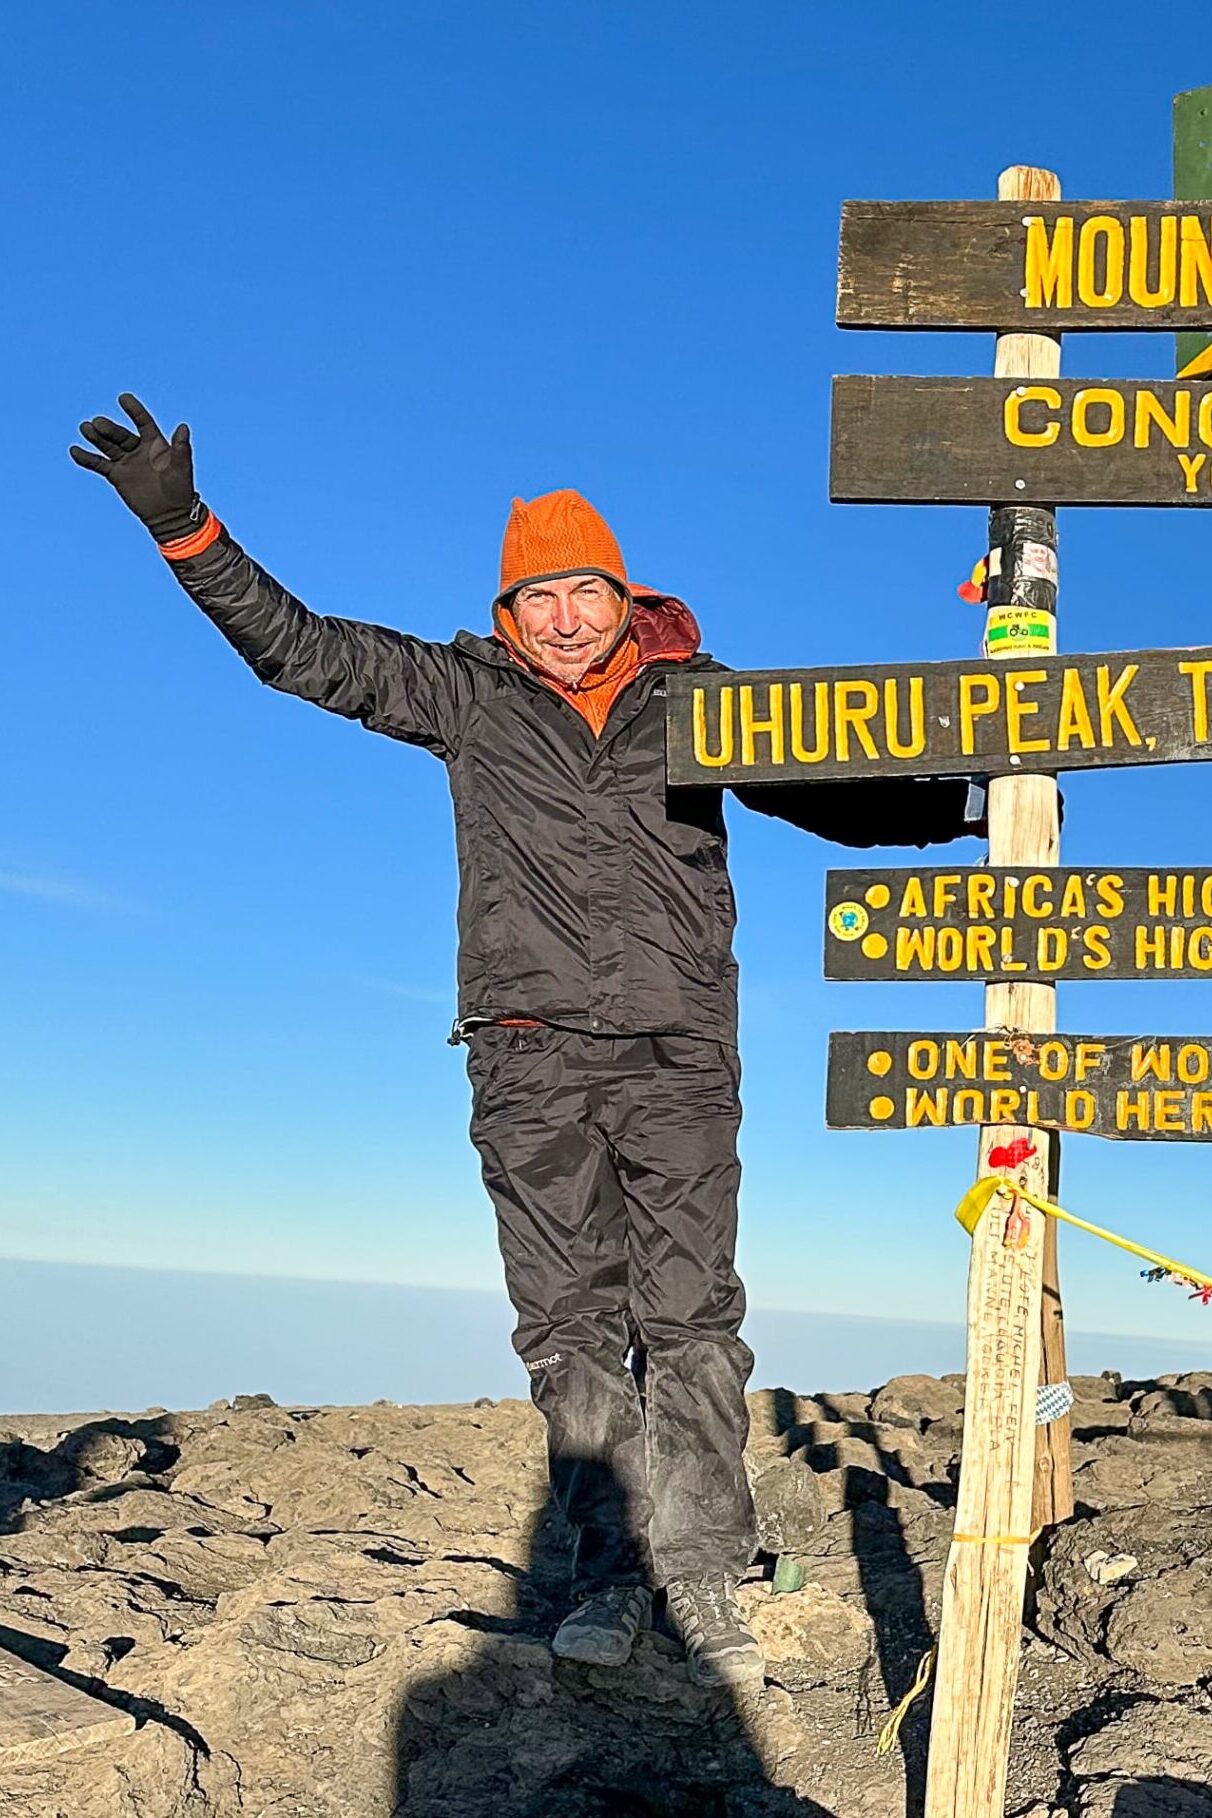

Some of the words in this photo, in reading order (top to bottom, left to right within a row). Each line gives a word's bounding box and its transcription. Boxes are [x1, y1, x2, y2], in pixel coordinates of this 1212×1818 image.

[692, 677, 926, 768] UHURU
[959, 664, 1157, 756] PEAK,
[899, 873, 1125, 920] AFRICA'S
[895, 925, 1112, 972] WORLD'S
[907, 1039, 1013, 1081] ONE
[1038, 1040, 1106, 1082] OF
[905, 1086, 1096, 1131] WORLD
